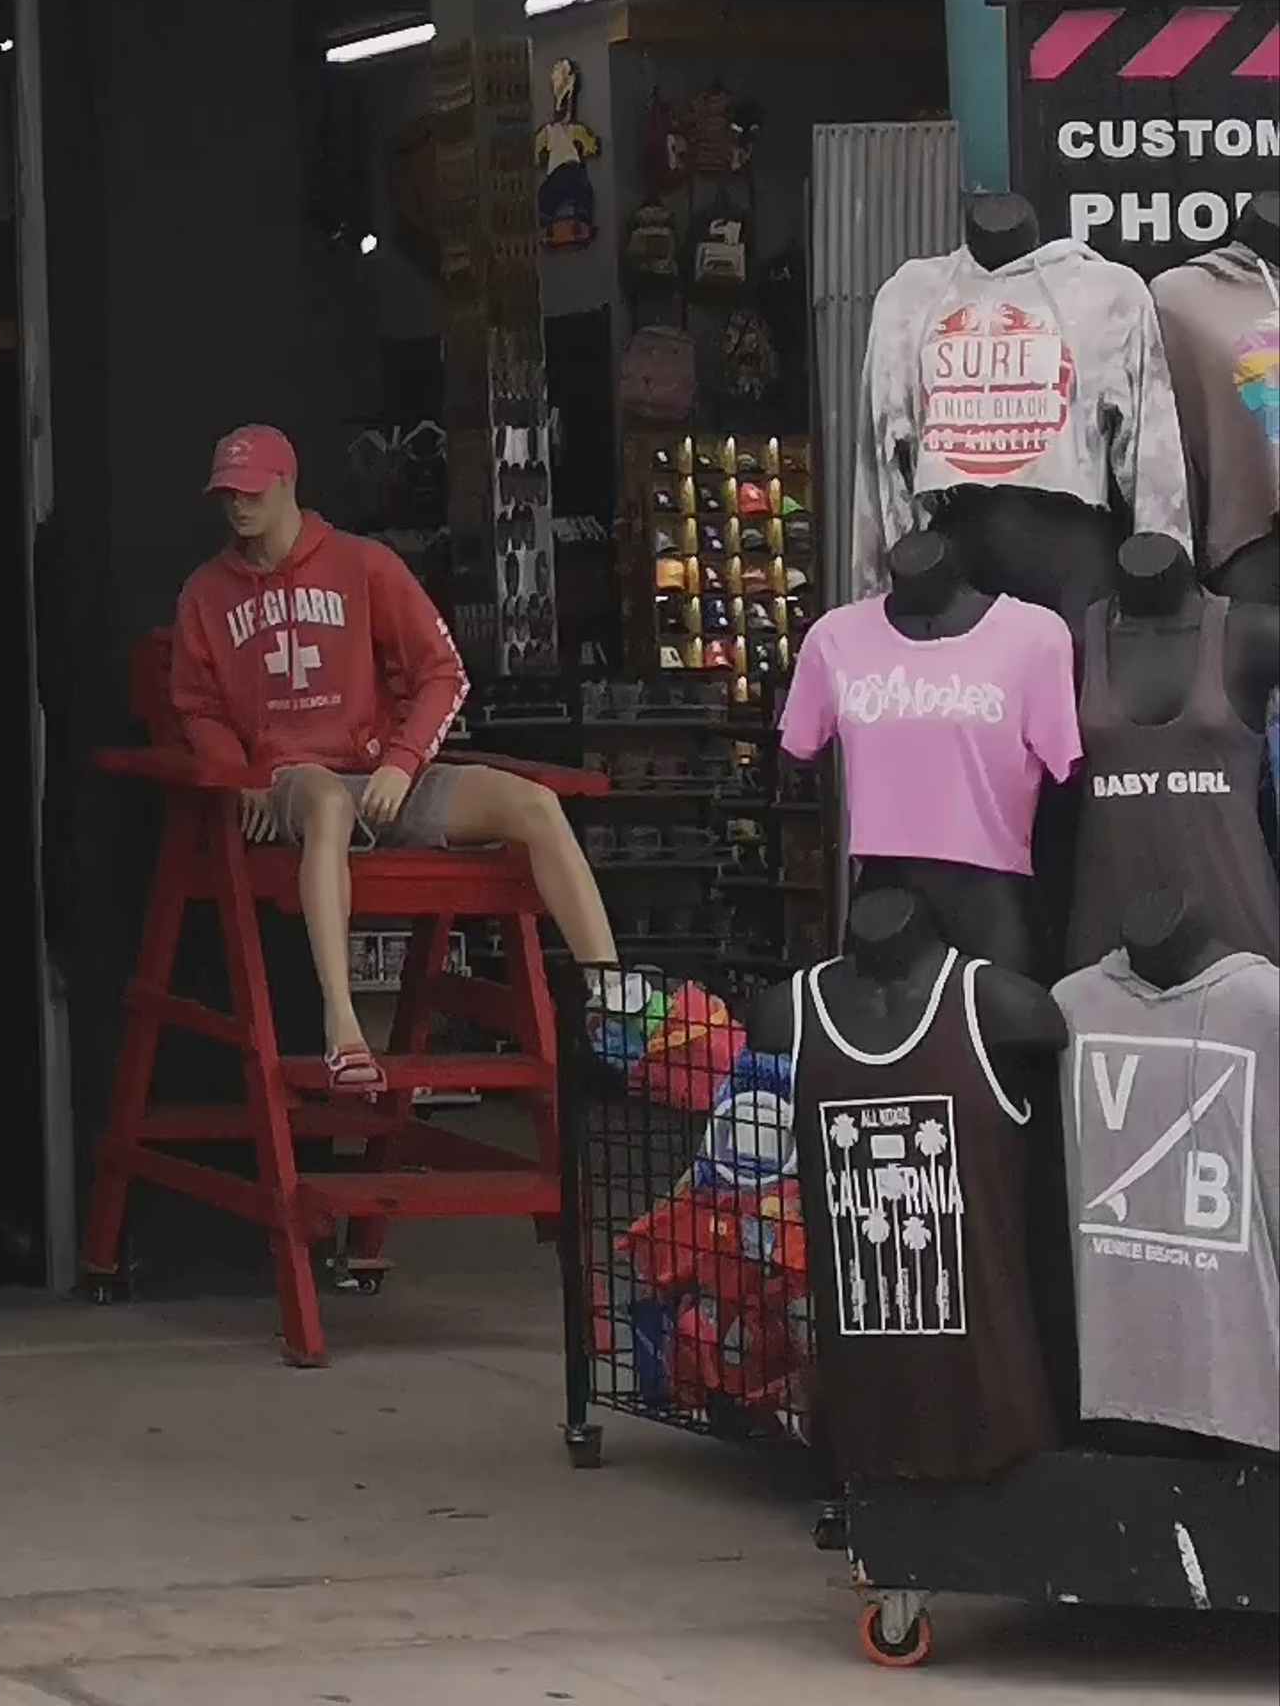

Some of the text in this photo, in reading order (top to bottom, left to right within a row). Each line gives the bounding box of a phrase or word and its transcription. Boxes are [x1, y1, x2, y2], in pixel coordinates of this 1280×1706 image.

[937, 339, 1035, 379] SURF
[928, 397, 984, 421] ENICE
[226, 586, 347, 651] LIFGUARD
[1093, 770, 1231, 798] BABY GIRL
[1091, 1051, 1142, 1131] V
[825, 1165, 965, 1217] CALIRNIA
[1184, 1150, 1230, 1229] B
[1194, 1251, 1219, 1270] CA
